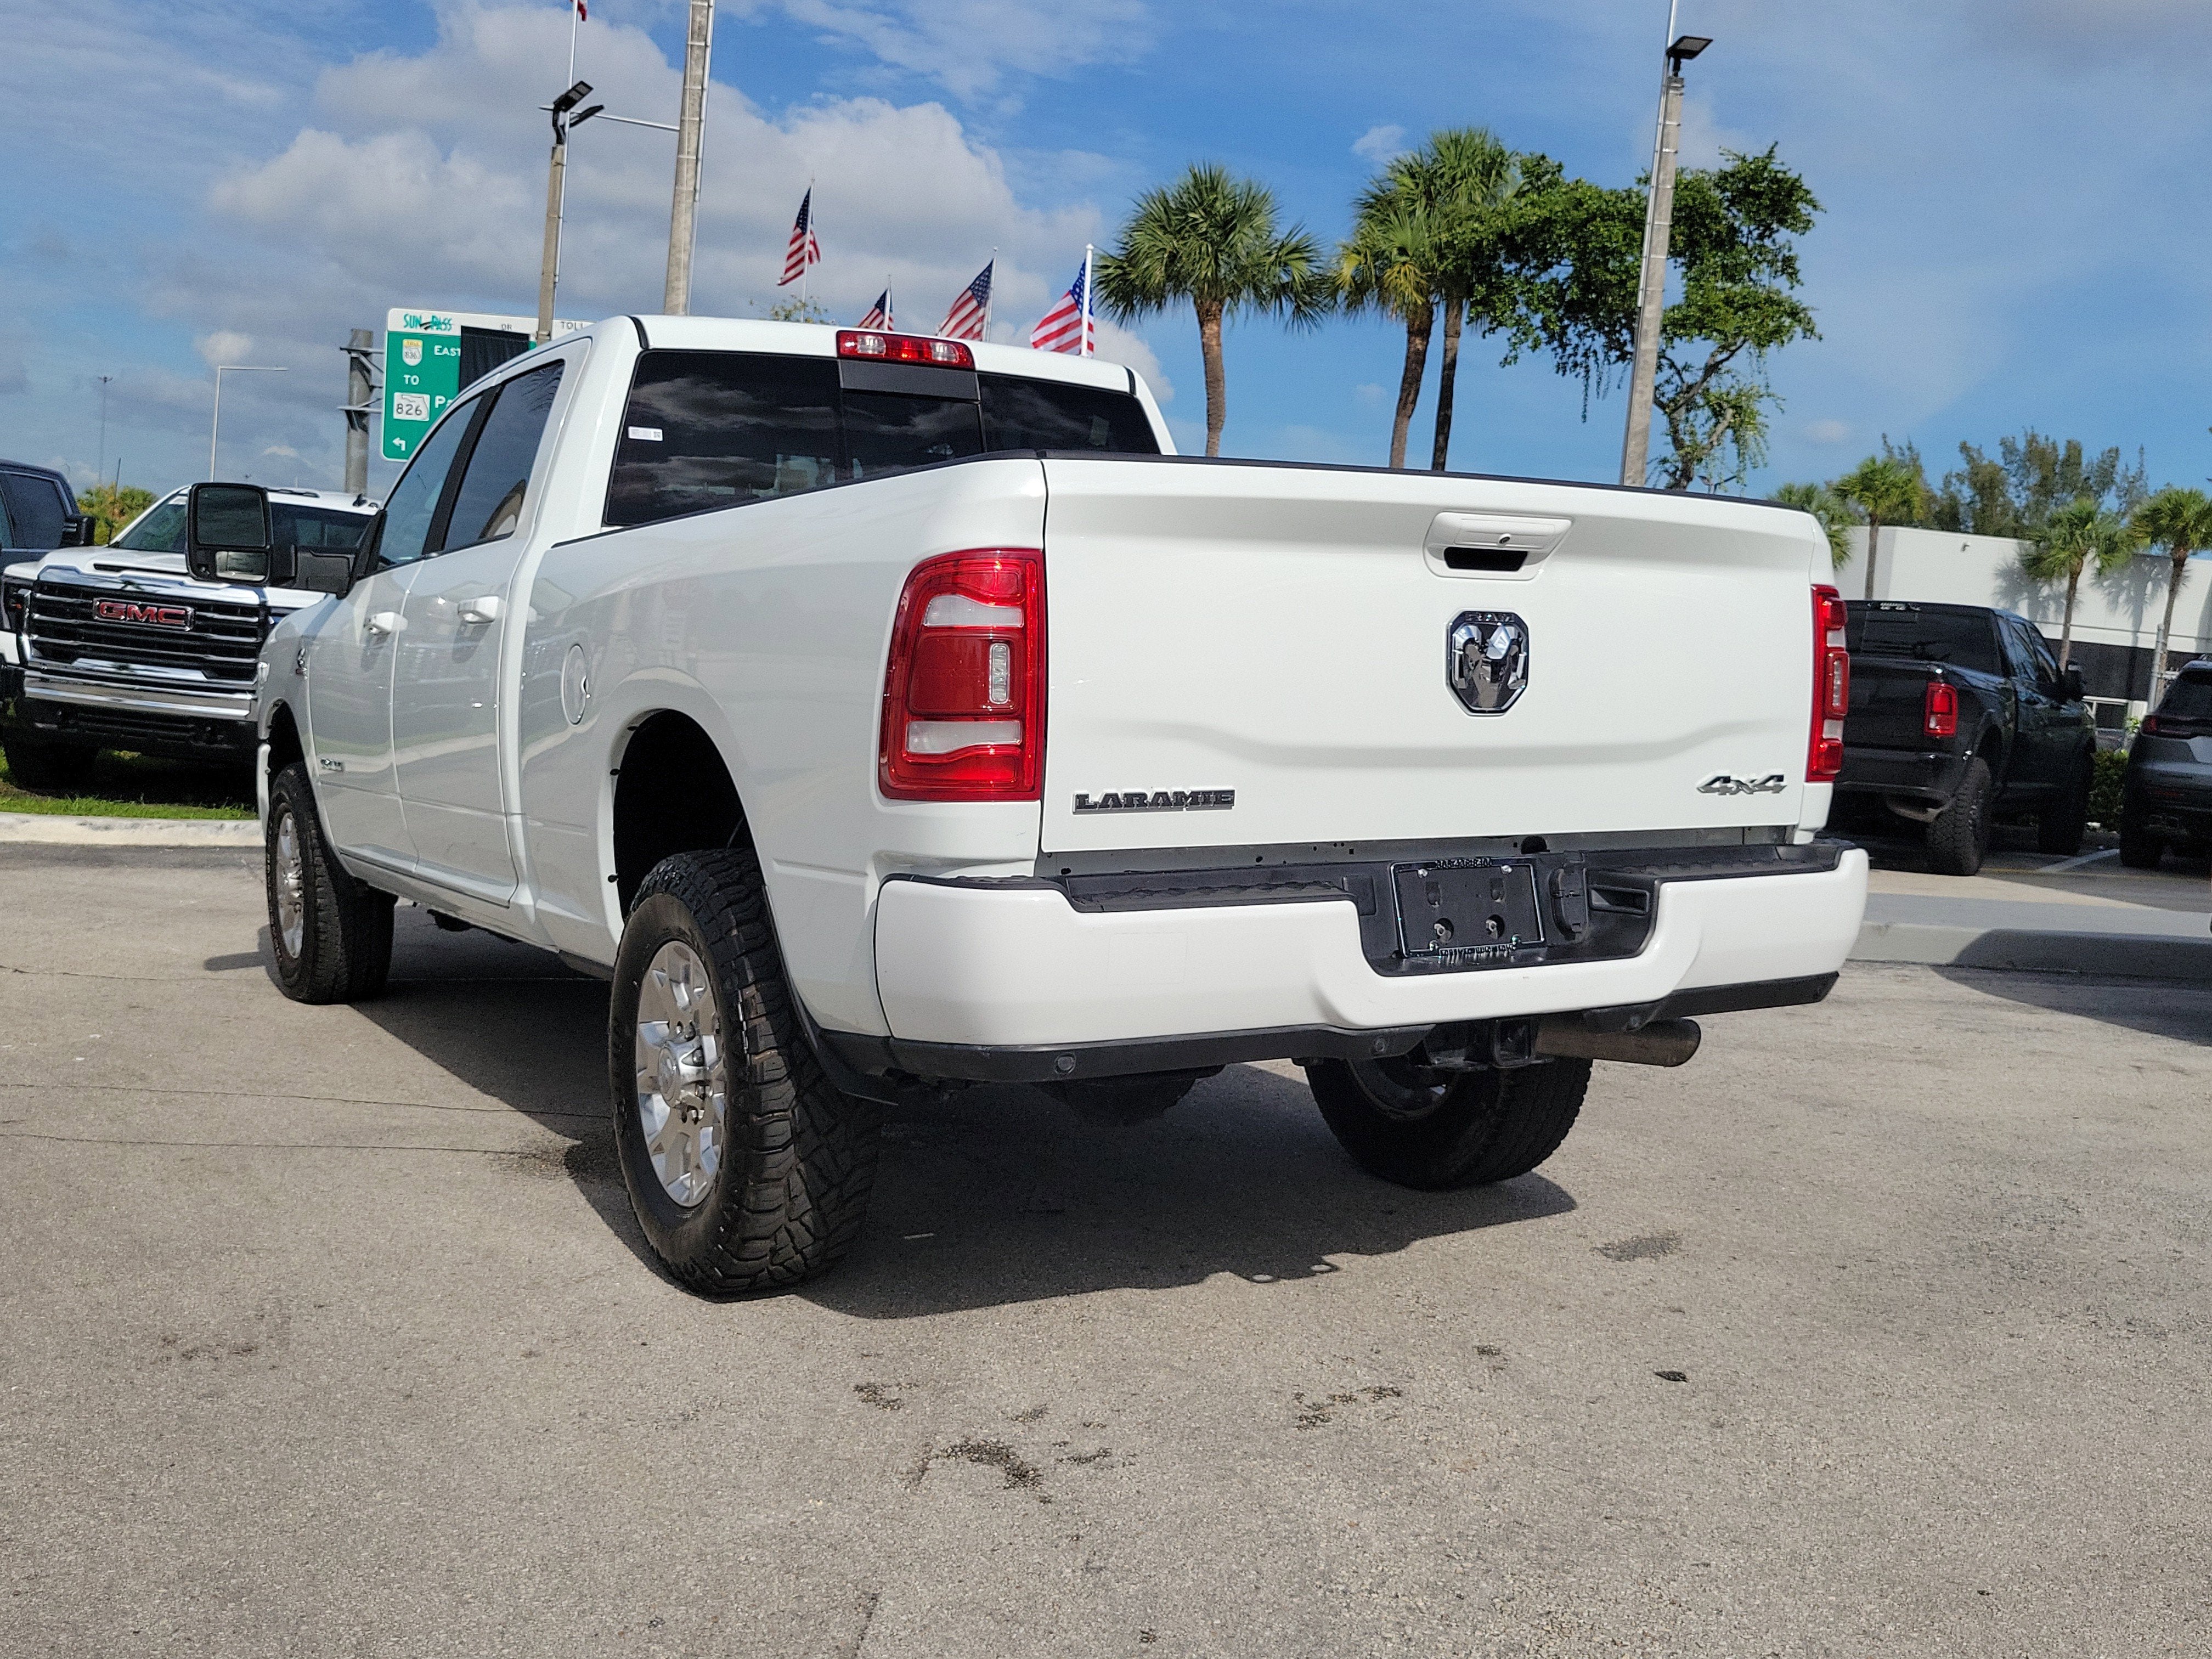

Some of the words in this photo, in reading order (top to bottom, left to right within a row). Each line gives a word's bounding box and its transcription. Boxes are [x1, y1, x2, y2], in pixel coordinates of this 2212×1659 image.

[403, 374, 419, 385] TO
[396, 403, 422, 416] 826
[99, 601, 186, 625] GMC
[1074, 788, 1235, 814] LARAMIE
